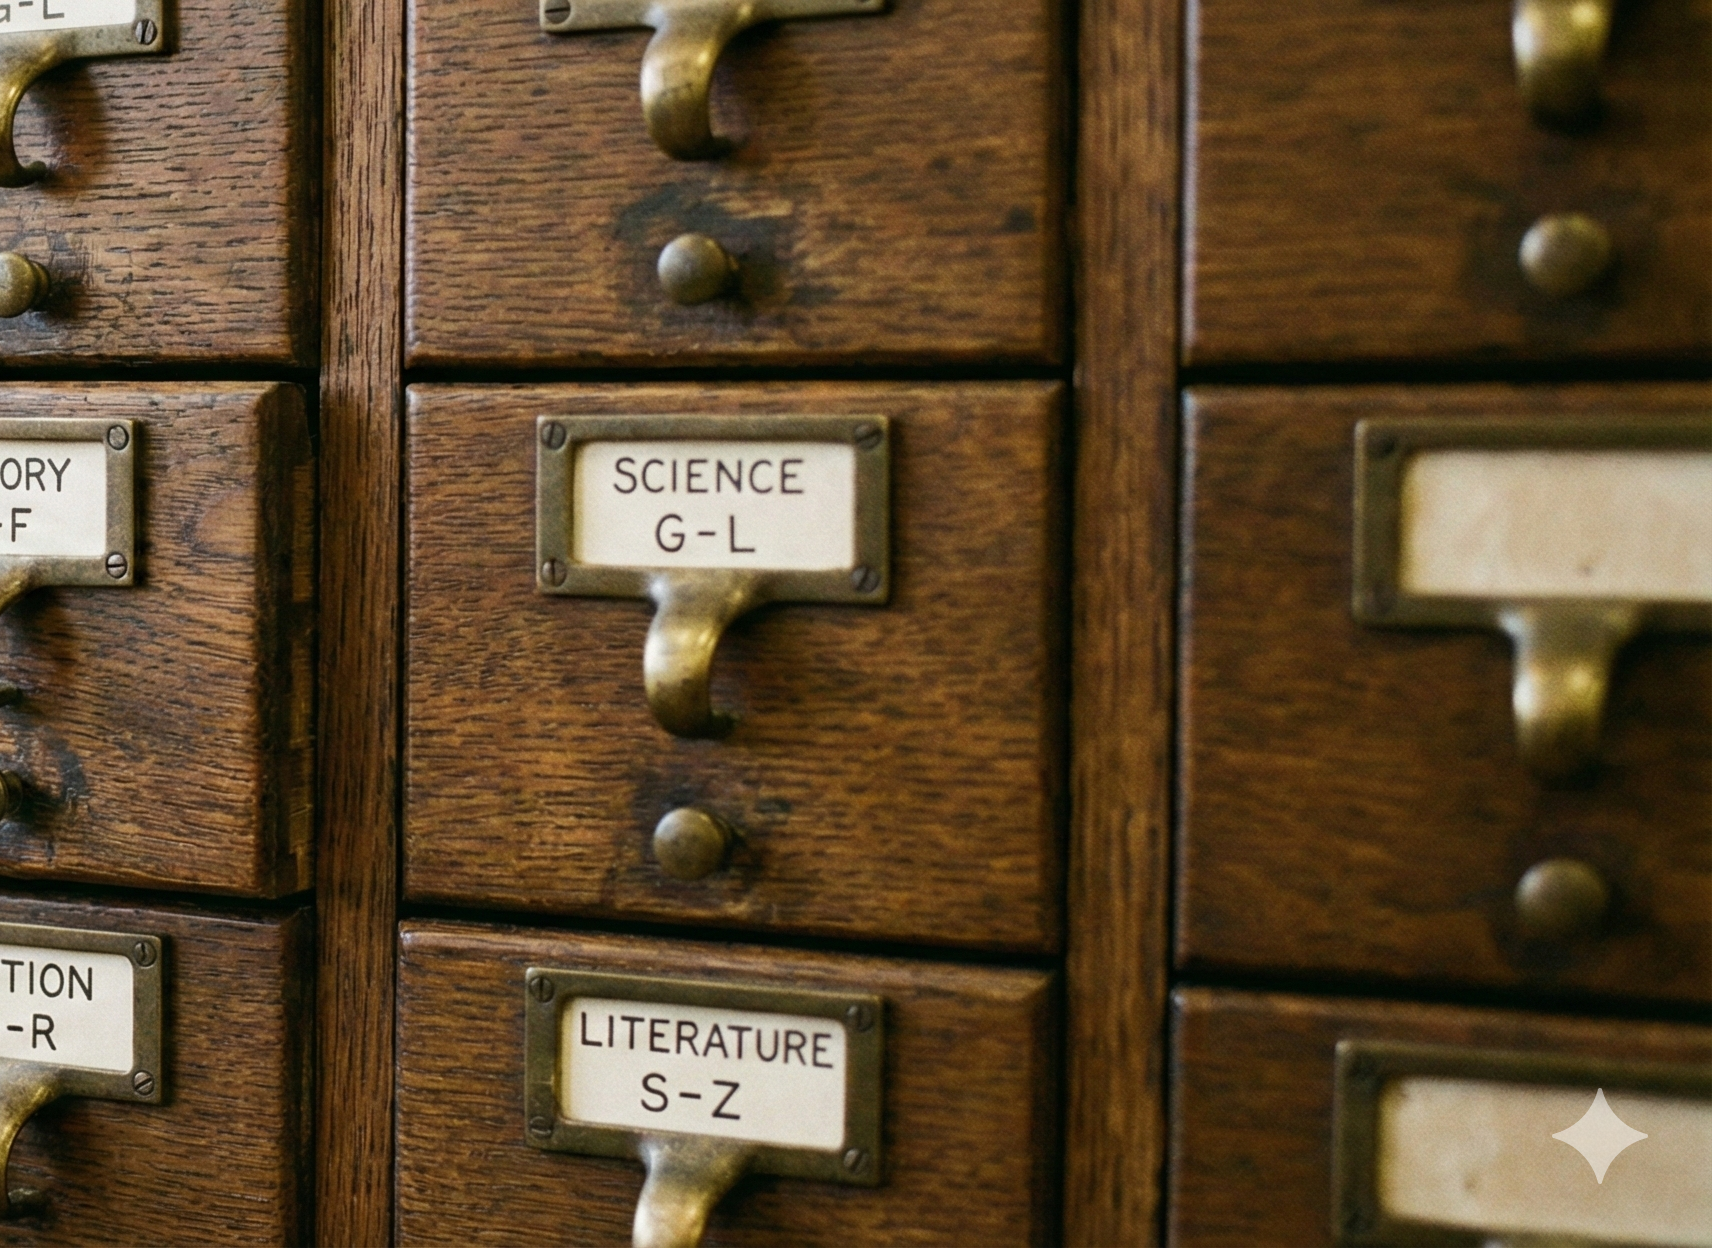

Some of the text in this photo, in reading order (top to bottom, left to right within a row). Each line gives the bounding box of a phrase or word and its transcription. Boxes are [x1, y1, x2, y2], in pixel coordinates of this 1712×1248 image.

[613, 456, 805, 495] SCIENCE
[654, 513, 756, 554] G-L
[579, 1010, 834, 1069] LITERATURE
[640, 1072, 742, 1122] S-Z
